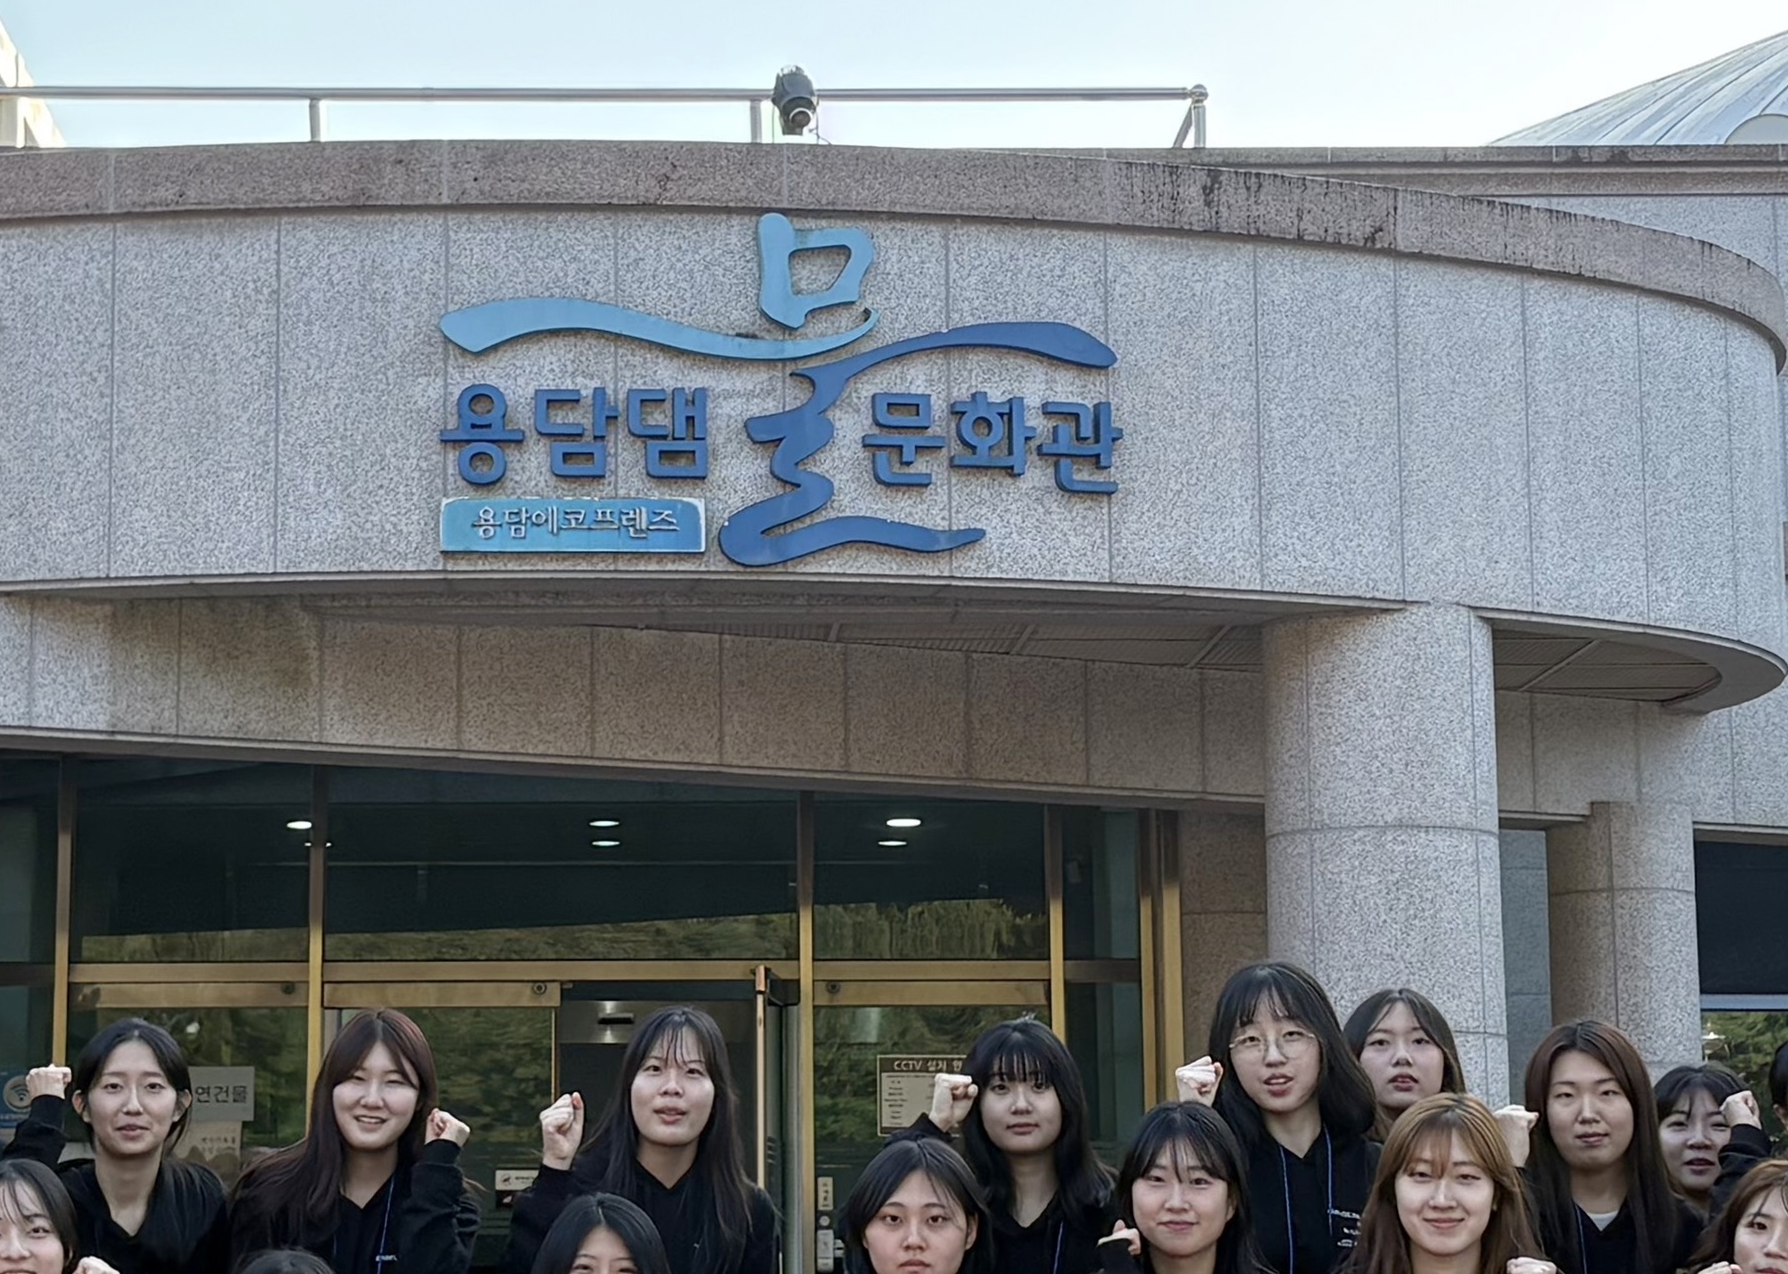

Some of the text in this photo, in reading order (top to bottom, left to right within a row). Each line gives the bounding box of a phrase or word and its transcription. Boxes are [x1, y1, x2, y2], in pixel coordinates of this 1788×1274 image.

[439, 382, 709, 486] 용담댐
[861, 391, 1125, 495] 문화관
[471, 505, 680, 540] 용담에코프렌즈
[894, 1060, 922, 1071] CCTV
[195, 1085, 247, 1103] 연건물
